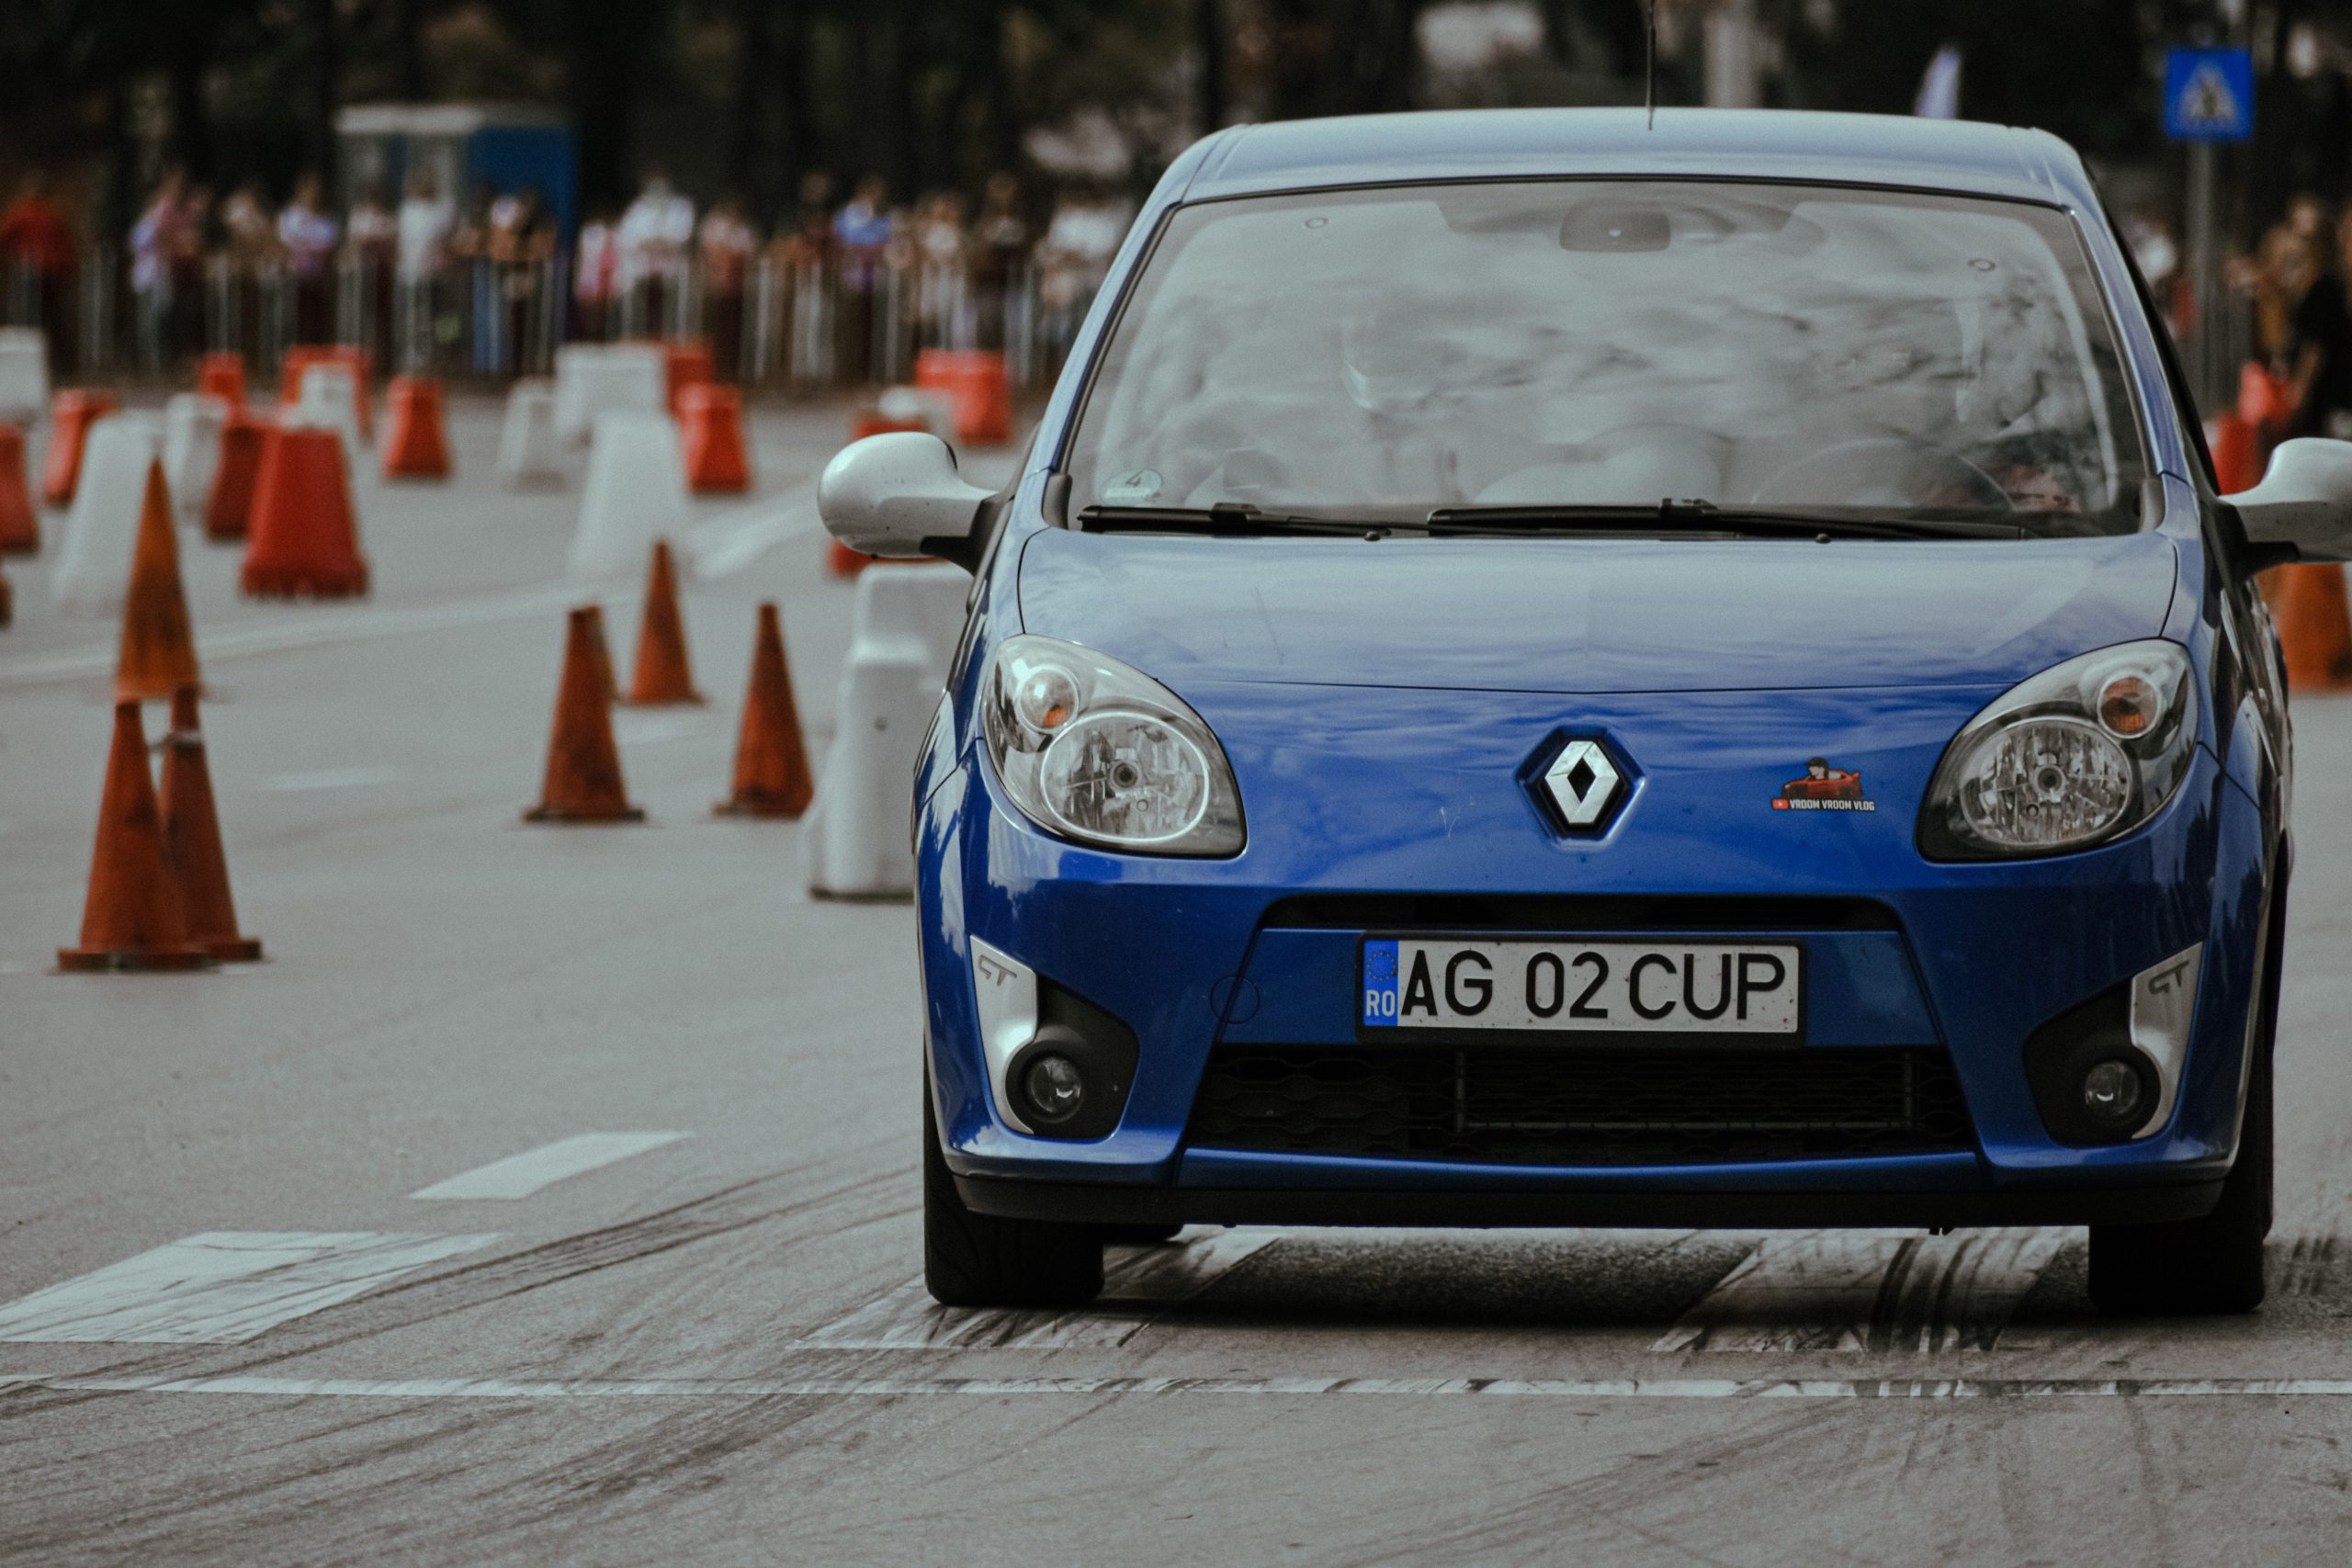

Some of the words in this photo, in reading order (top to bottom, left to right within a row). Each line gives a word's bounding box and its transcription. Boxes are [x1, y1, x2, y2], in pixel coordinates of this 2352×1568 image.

[1790, 799, 1820, 809] VROOM
[1822, 799, 1852, 810] VROOM
[1853, 800, 1875, 811] VLOG
[1401, 950, 1493, 1016] AG
[1526, 951, 1609, 1019] 02
[1629, 953, 1785, 1021] CUP
[1366, 990, 1396, 1017] RO
